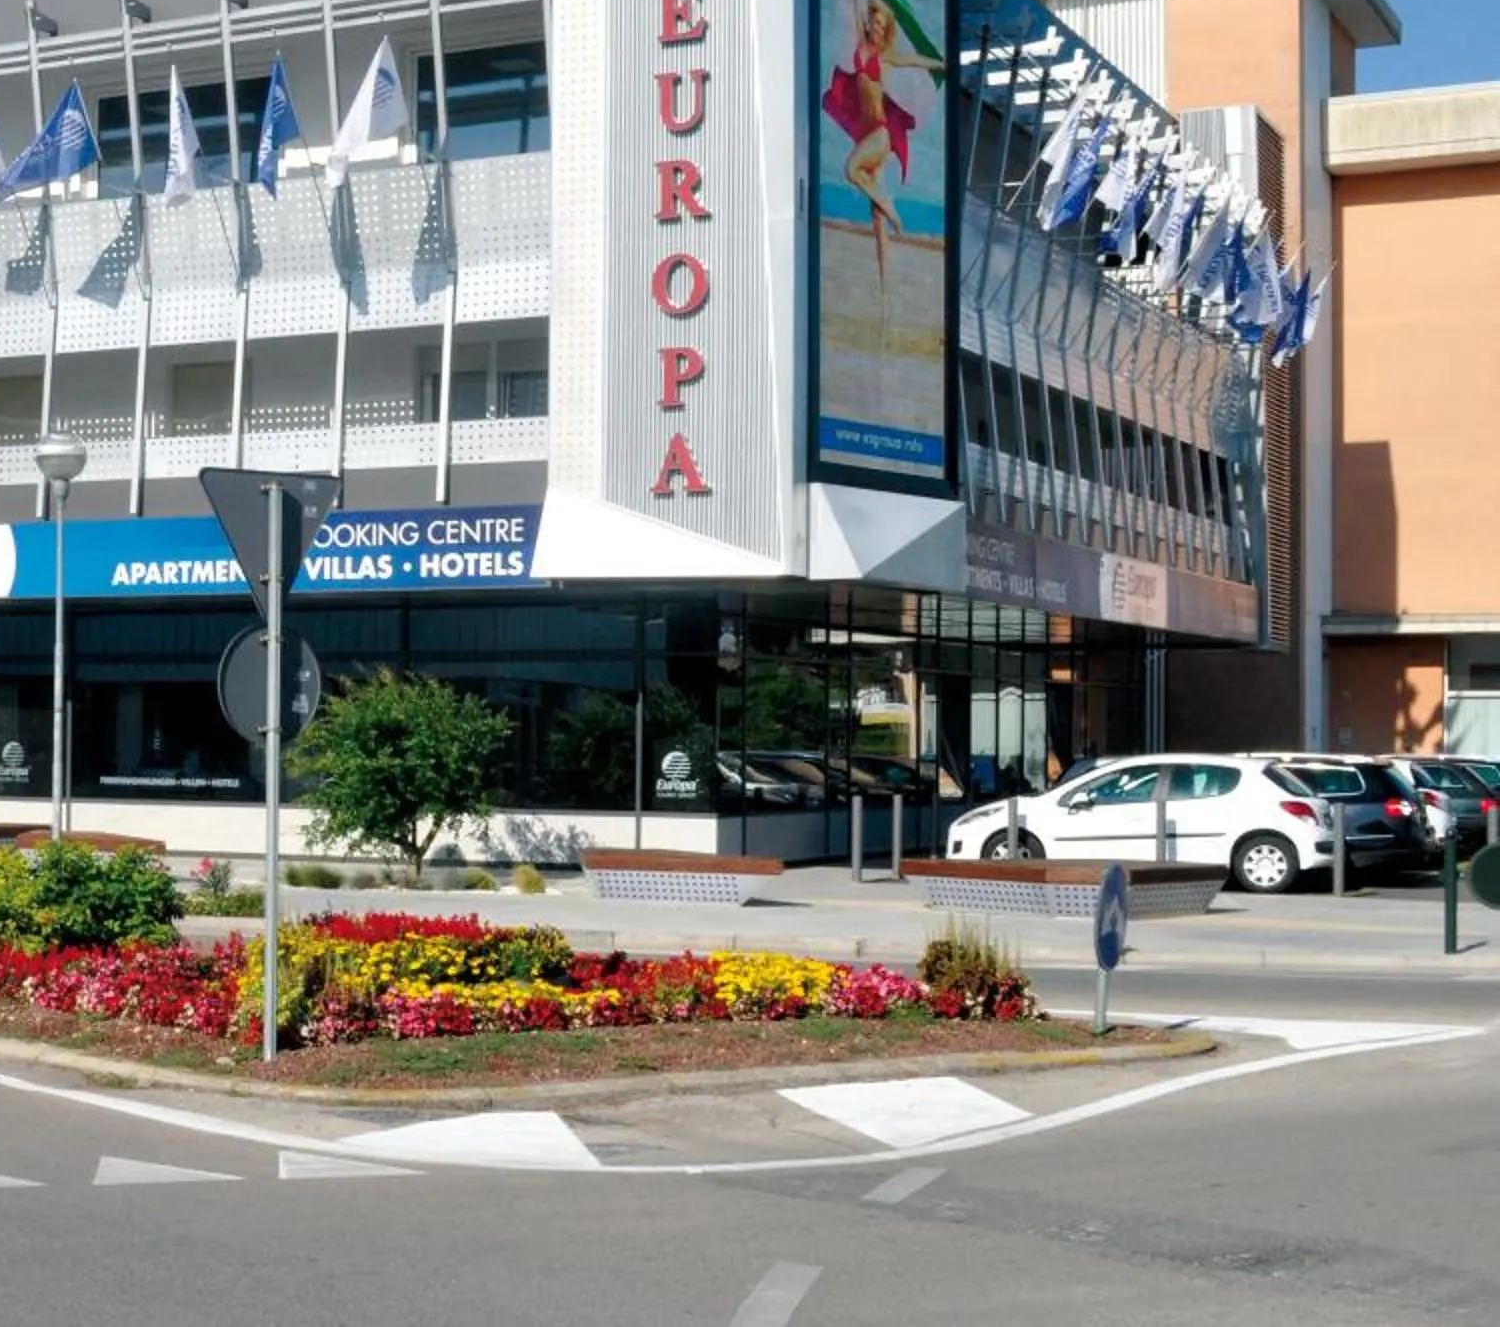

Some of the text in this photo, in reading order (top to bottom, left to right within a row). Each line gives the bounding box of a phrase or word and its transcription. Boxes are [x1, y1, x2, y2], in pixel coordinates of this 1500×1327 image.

[313, 518, 525, 548] OOKING CENTRE
[111, 551, 525, 586] APARTMEN VILLAS HOTELS
